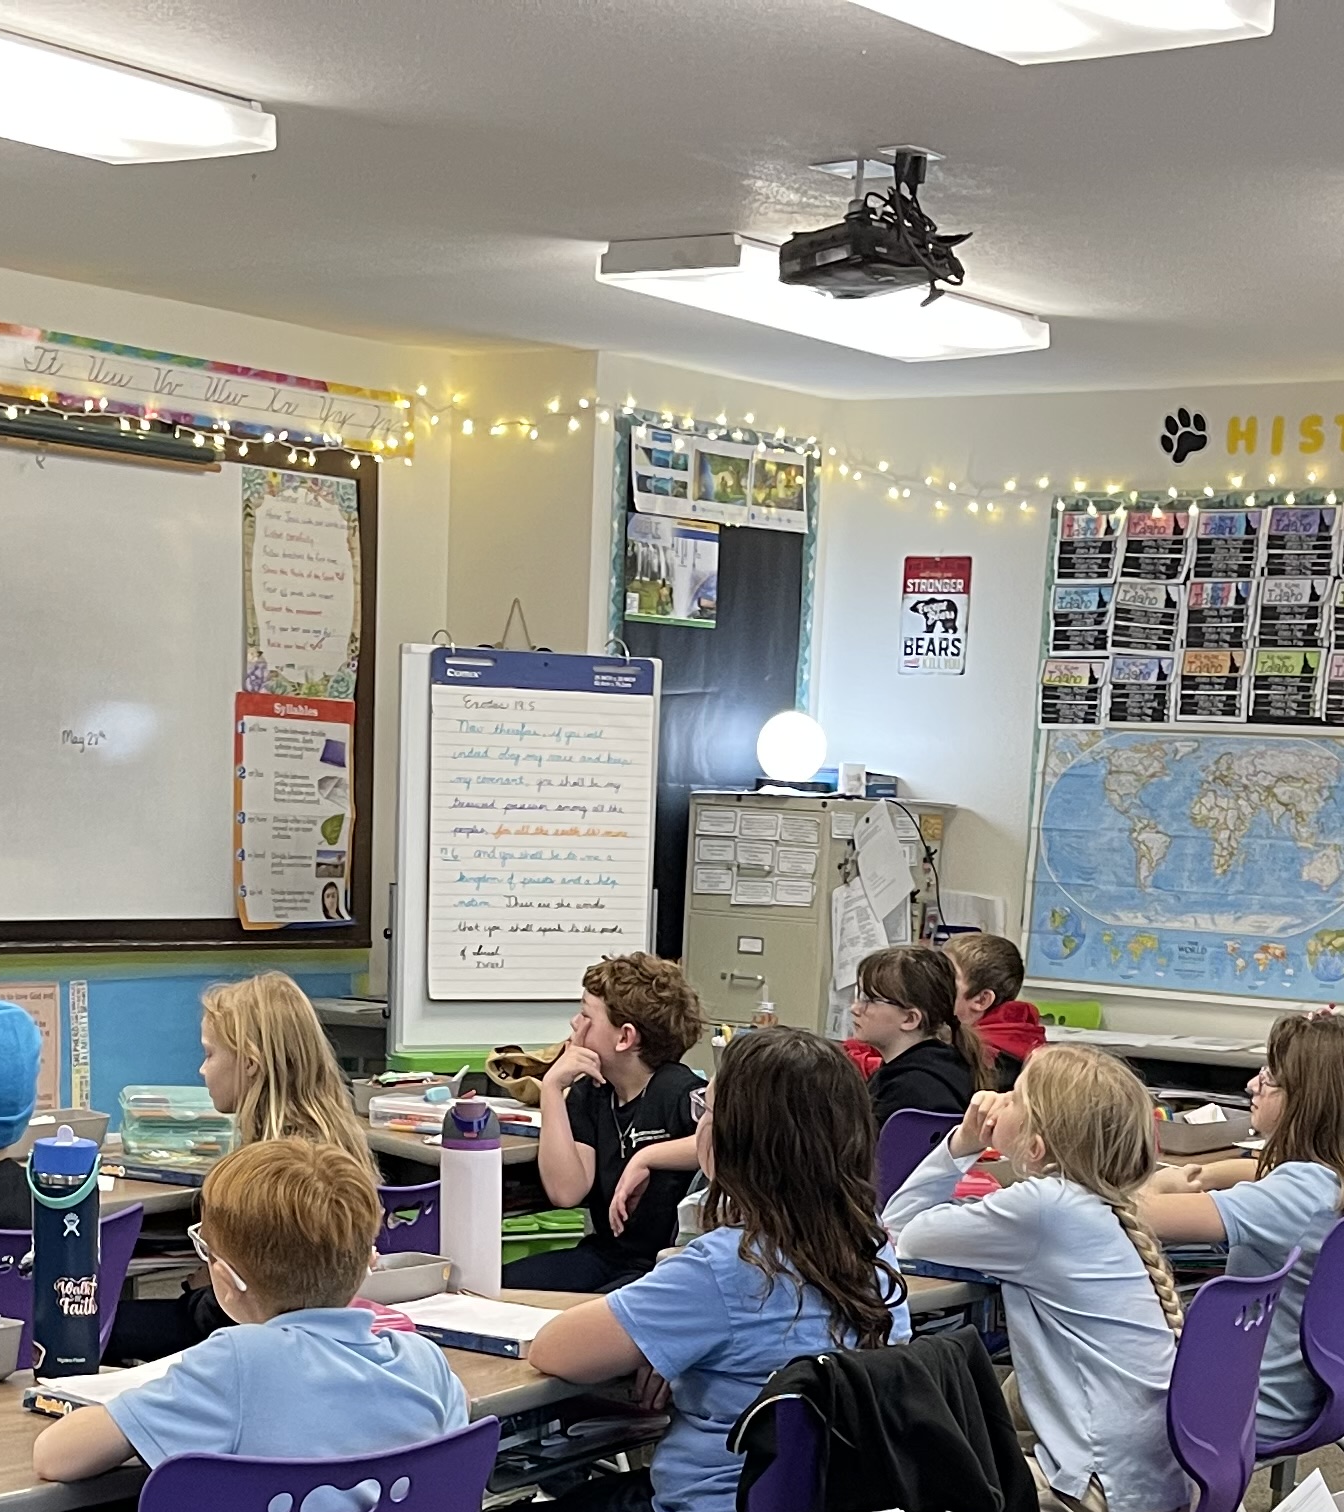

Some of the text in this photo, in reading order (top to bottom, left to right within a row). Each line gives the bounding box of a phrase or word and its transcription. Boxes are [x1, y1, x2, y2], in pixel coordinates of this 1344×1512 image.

[25, 345, 62, 376] Tt
[88, 355, 134, 388] Uu
[152, 367, 183, 393] Vv
[204, 376, 249, 407] Ww
[906, 579, 964, 593] STRONGER
[1058, 596, 1092, 609] Idaho
[1121, 590, 1158, 605] Idaho
[1266, 589, 1303, 603] Idaho
[904, 637, 962, 657] BEARS
[922, 658, 960, 669] KILL YOU
[1188, 660, 1223, 673] Idaho
[1259, 660, 1294, 674] Idaho
[1047, 671, 1082, 684] Idaho
[274, 703, 318, 716] Syllables
[239, 722, 245, 734] 1
[580, 755, 602, 764] and
[238, 767, 246, 779] 2
[237, 812, 245, 824] 3
[237, 849, 245, 861] 4
[240, 886, 247, 897] 5
[1178, 944, 1207, 954] WORLD
[59, 1280, 91, 1295] Walk
[60, 1297, 97, 1316] Faith
